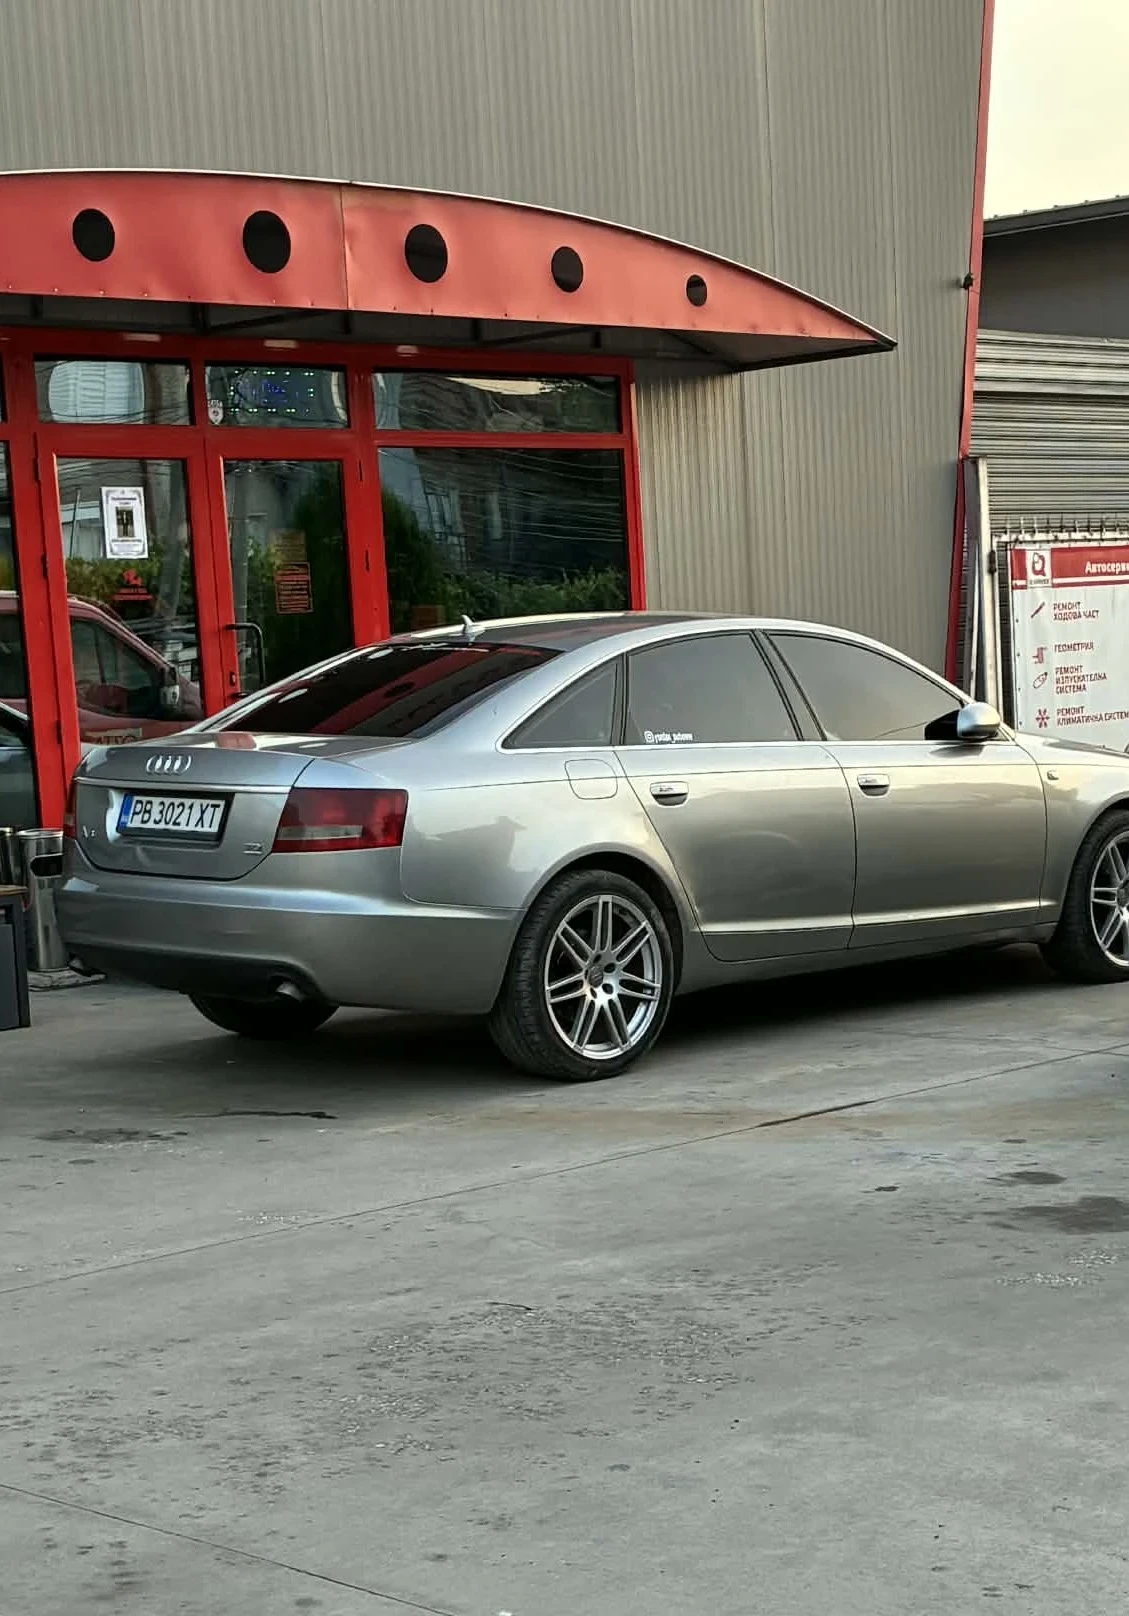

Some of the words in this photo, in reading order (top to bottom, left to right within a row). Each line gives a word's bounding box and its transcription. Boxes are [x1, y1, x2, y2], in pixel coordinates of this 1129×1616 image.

[1053, 601, 1081, 611] РЕМОНТ
[1053, 611, 1082, 621] ХОДОВА
[1083, 609, 1099, 619] ЧАСТ
[1054, 642, 1094, 653] ГЕОМЕТРИЯ
[1055, 665, 1083, 675] РЕМОНТ
[1056, 673, 1107, 684] ИЗПУСКАТЕЛНА
[1056, 684, 1087, 694] СИСТЕМА
[1057, 706, 1085, 716] РЕМОНТ
[1057, 713, 1103, 726] КЛИМАТИЧНА
[130, 799, 153, 824] PB
[153, 801, 194, 826] 3021
[194, 803, 220, 828] XT
